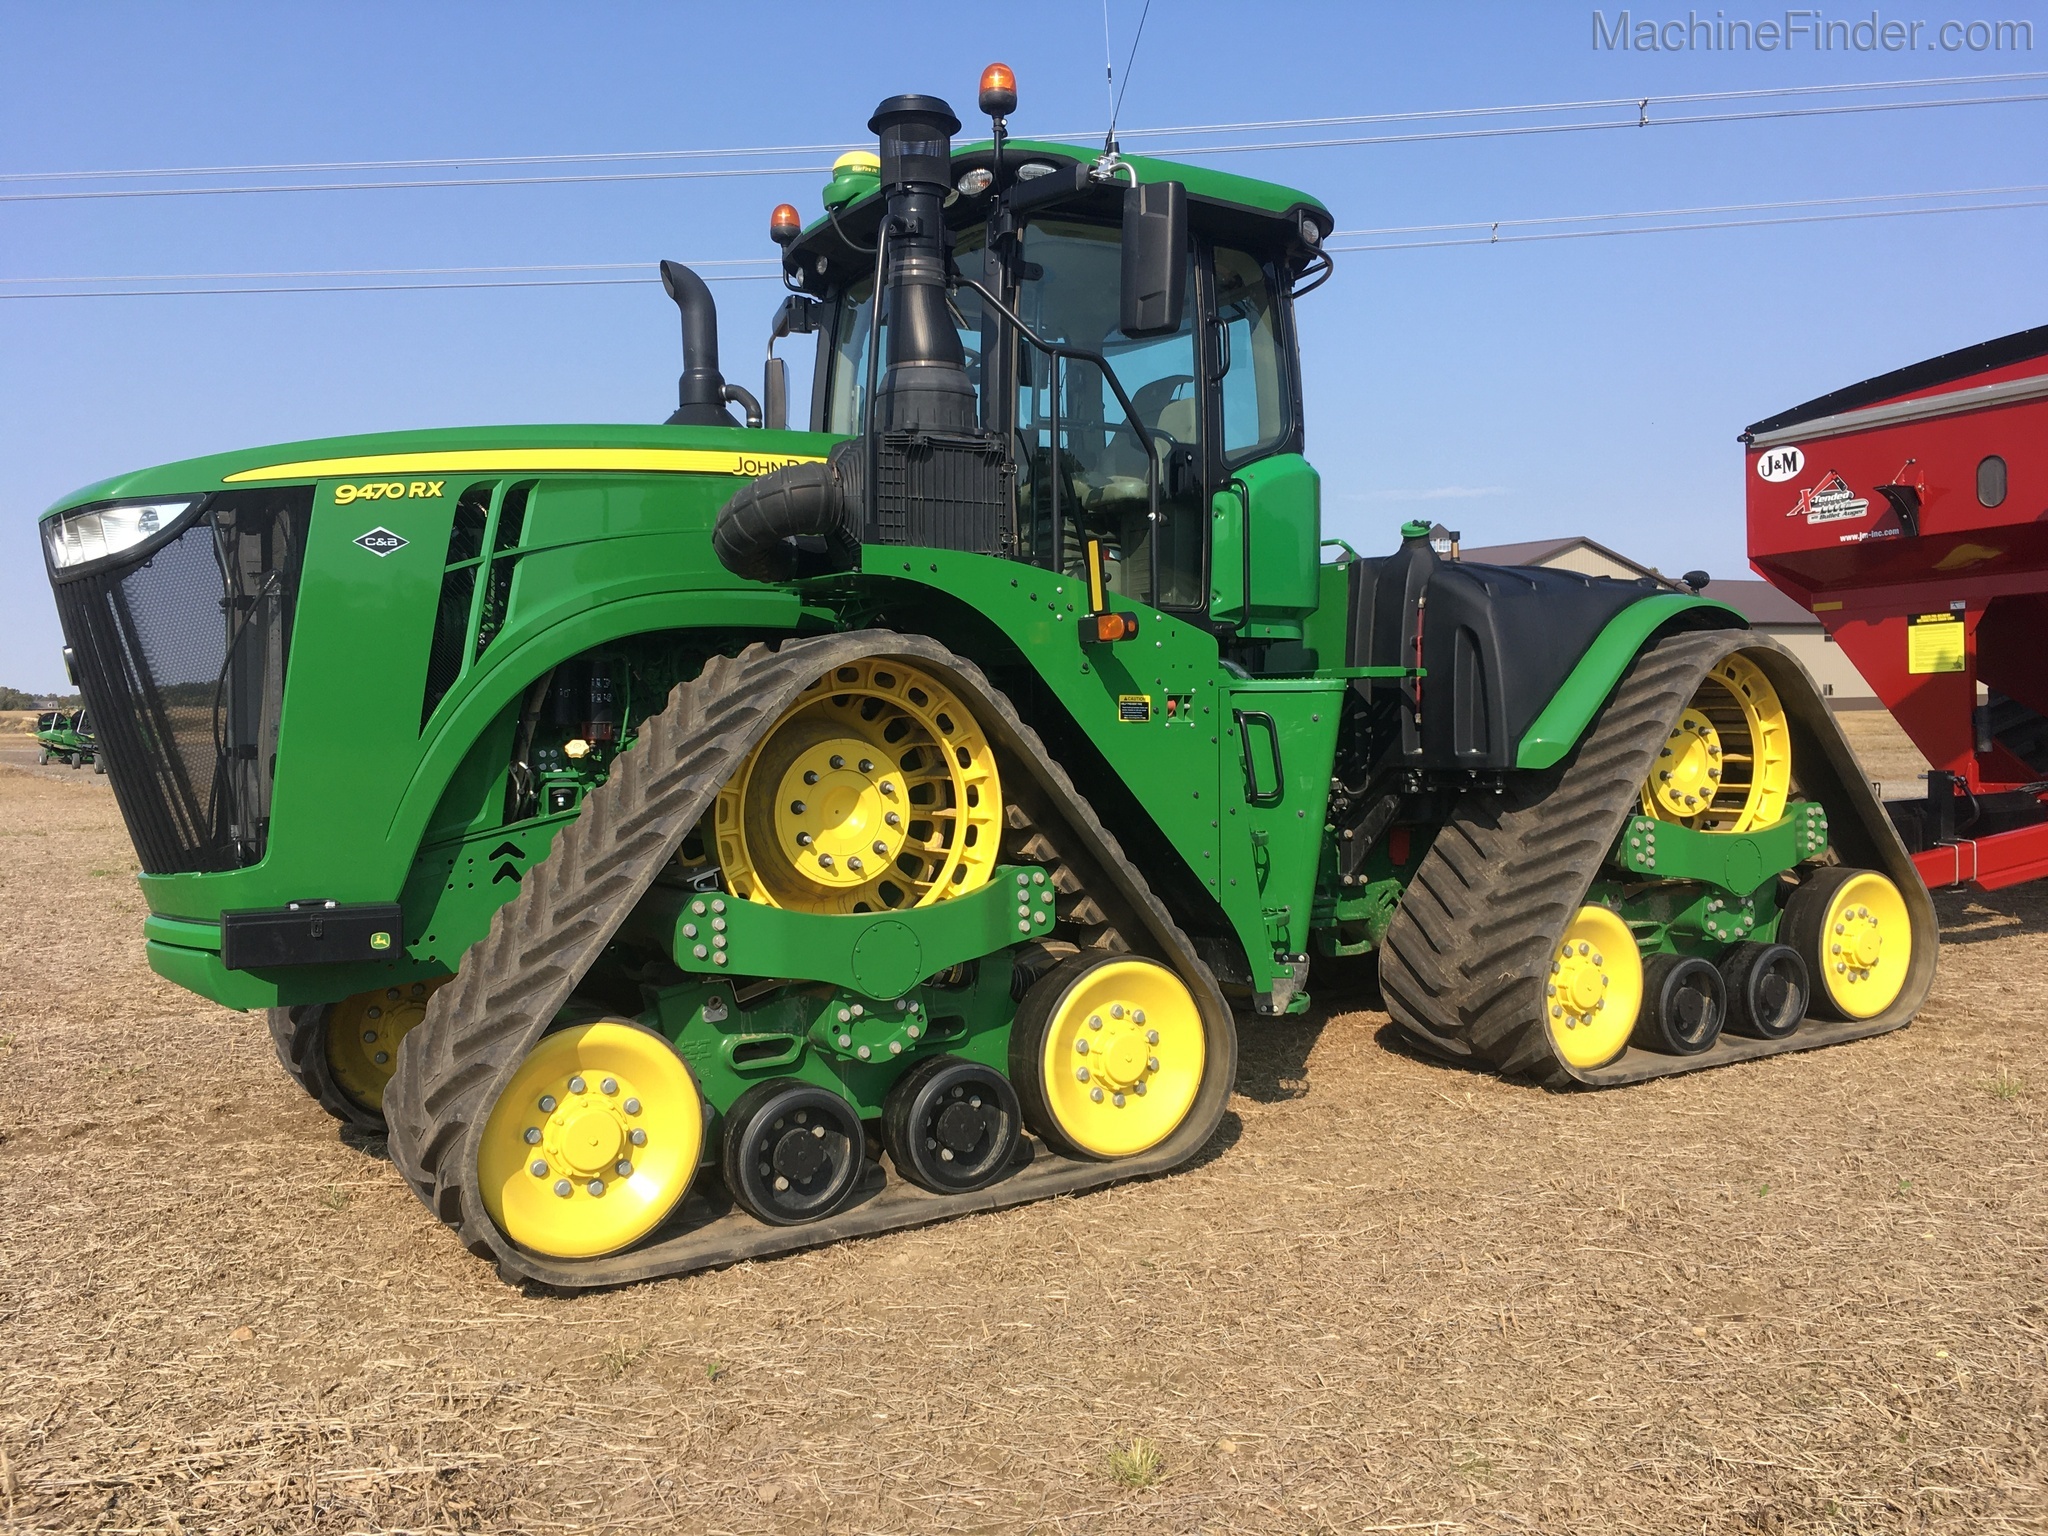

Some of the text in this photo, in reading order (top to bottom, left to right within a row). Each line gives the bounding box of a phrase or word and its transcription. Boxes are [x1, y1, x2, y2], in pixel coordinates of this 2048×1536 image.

[1761, 450, 1798, 477] J&M
[334, 481, 446, 505] 9470 RX
[1819, 512, 1840, 520] Bullet
[1842, 509, 1864, 517] Auger
[364, 537, 398, 546] C&B
[1839, 528, 1900, 542] www.jm-inc.com
